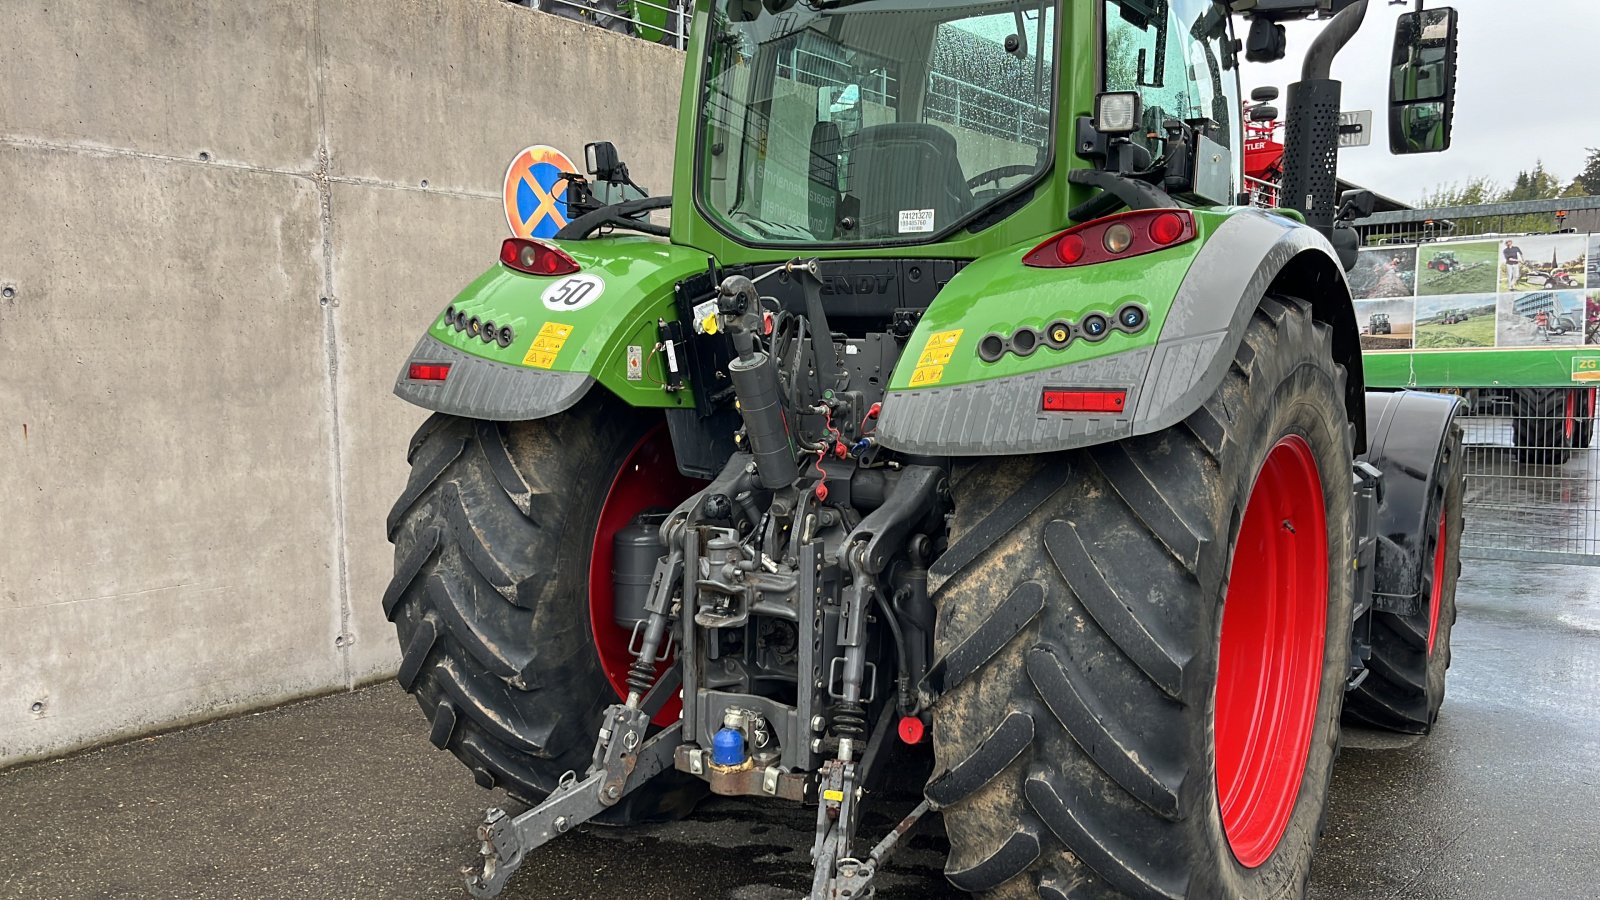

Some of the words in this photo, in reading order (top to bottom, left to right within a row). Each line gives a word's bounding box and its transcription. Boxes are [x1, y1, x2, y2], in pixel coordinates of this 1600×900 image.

[549, 278, 596, 306] 50
[819, 274, 896, 296] ENDT
[1579, 359, 1597, 369] ZG
